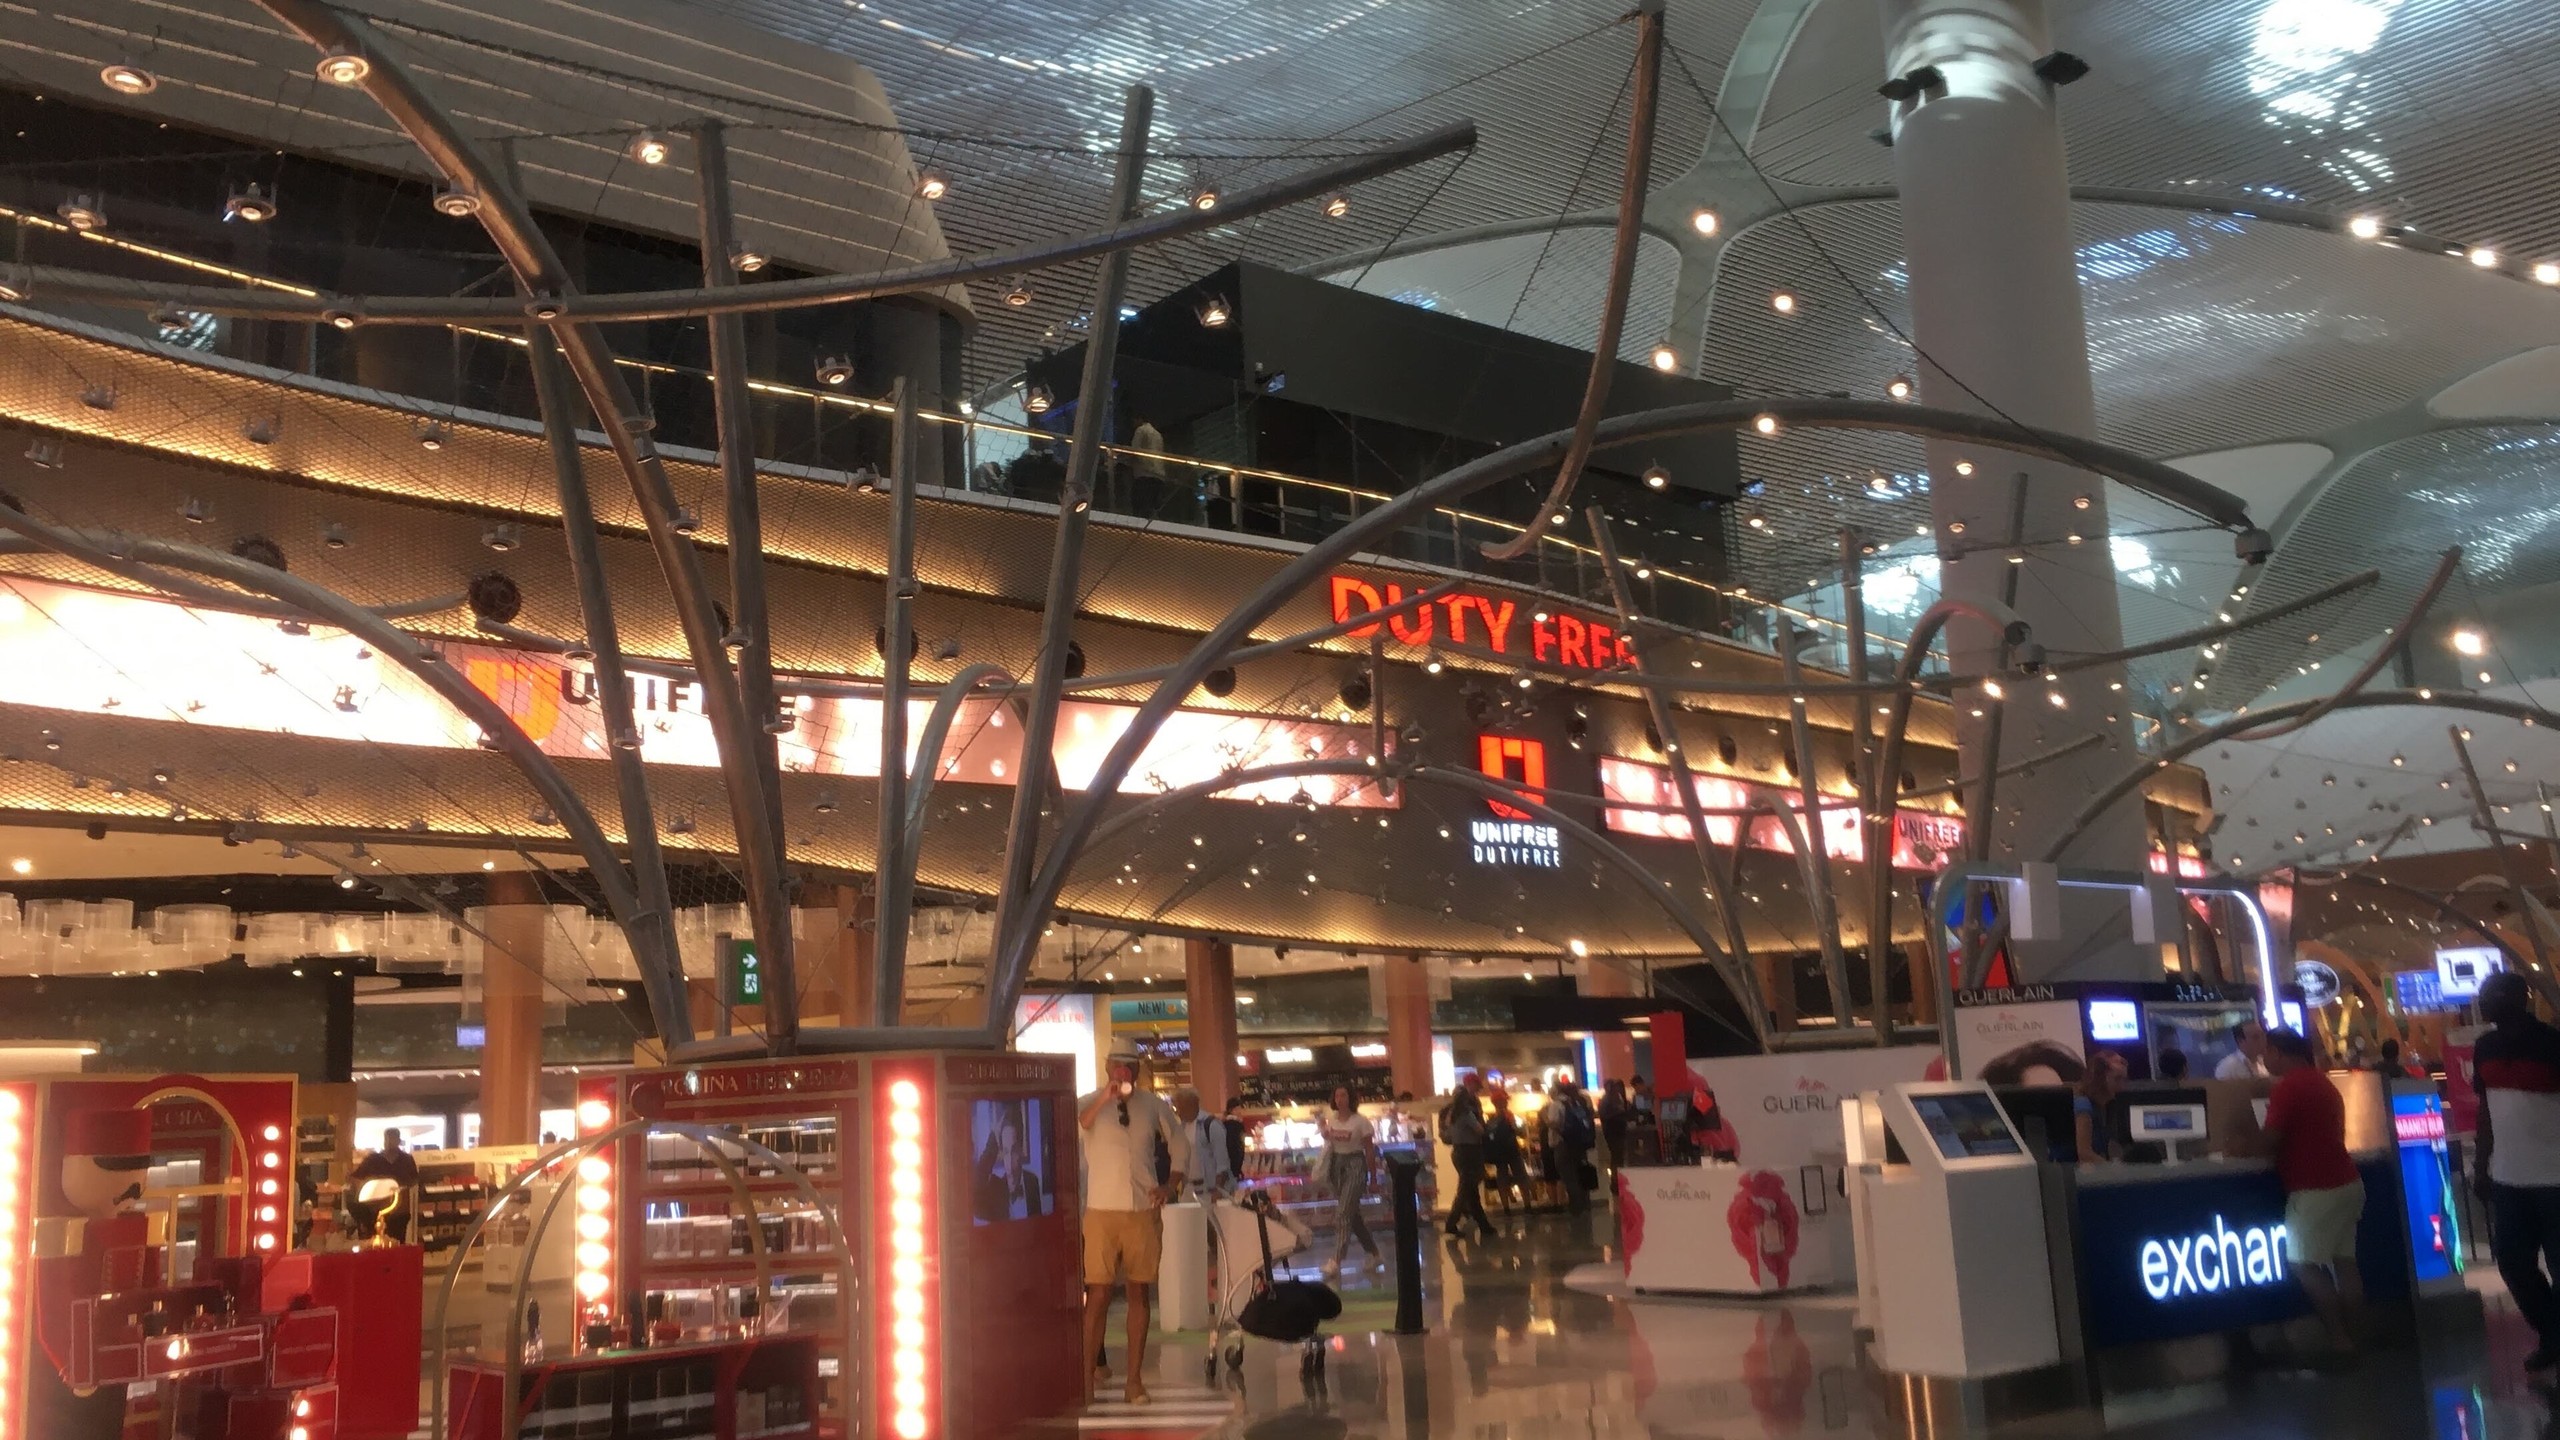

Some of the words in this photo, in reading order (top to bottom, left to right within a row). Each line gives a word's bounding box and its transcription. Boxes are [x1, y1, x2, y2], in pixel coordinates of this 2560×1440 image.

[1330, 576, 1515, 653] DUTY
[1471, 821, 1559, 848] UNIFREE
[1898, 817, 1960, 849] UNIFREE
[1958, 984, 2056, 1006] GUERLAIN
[1976, 1020, 2044, 1035] GUERLAIN
[1763, 1092, 1861, 1115] GUERLA
